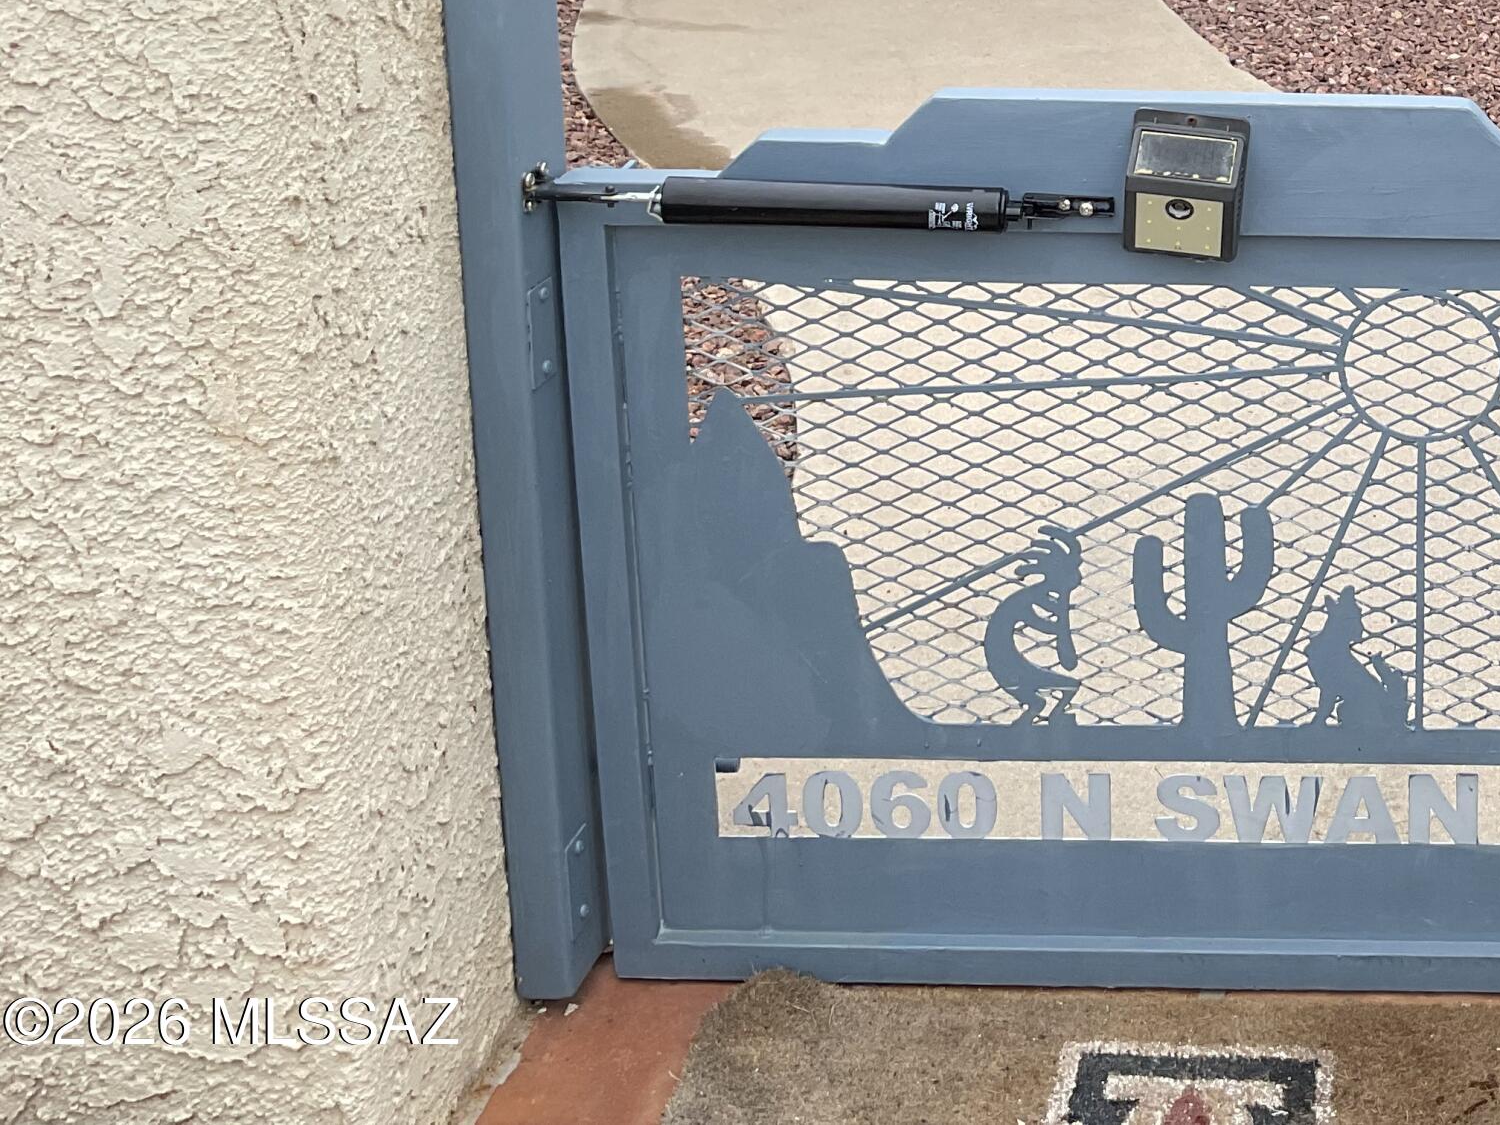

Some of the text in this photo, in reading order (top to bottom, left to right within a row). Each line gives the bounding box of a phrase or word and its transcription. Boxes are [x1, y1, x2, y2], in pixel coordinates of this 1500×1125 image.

[733, 771, 998, 839] 4060
[1041, 773, 1112, 840] N
[1155, 774, 1479, 845] SWAN
